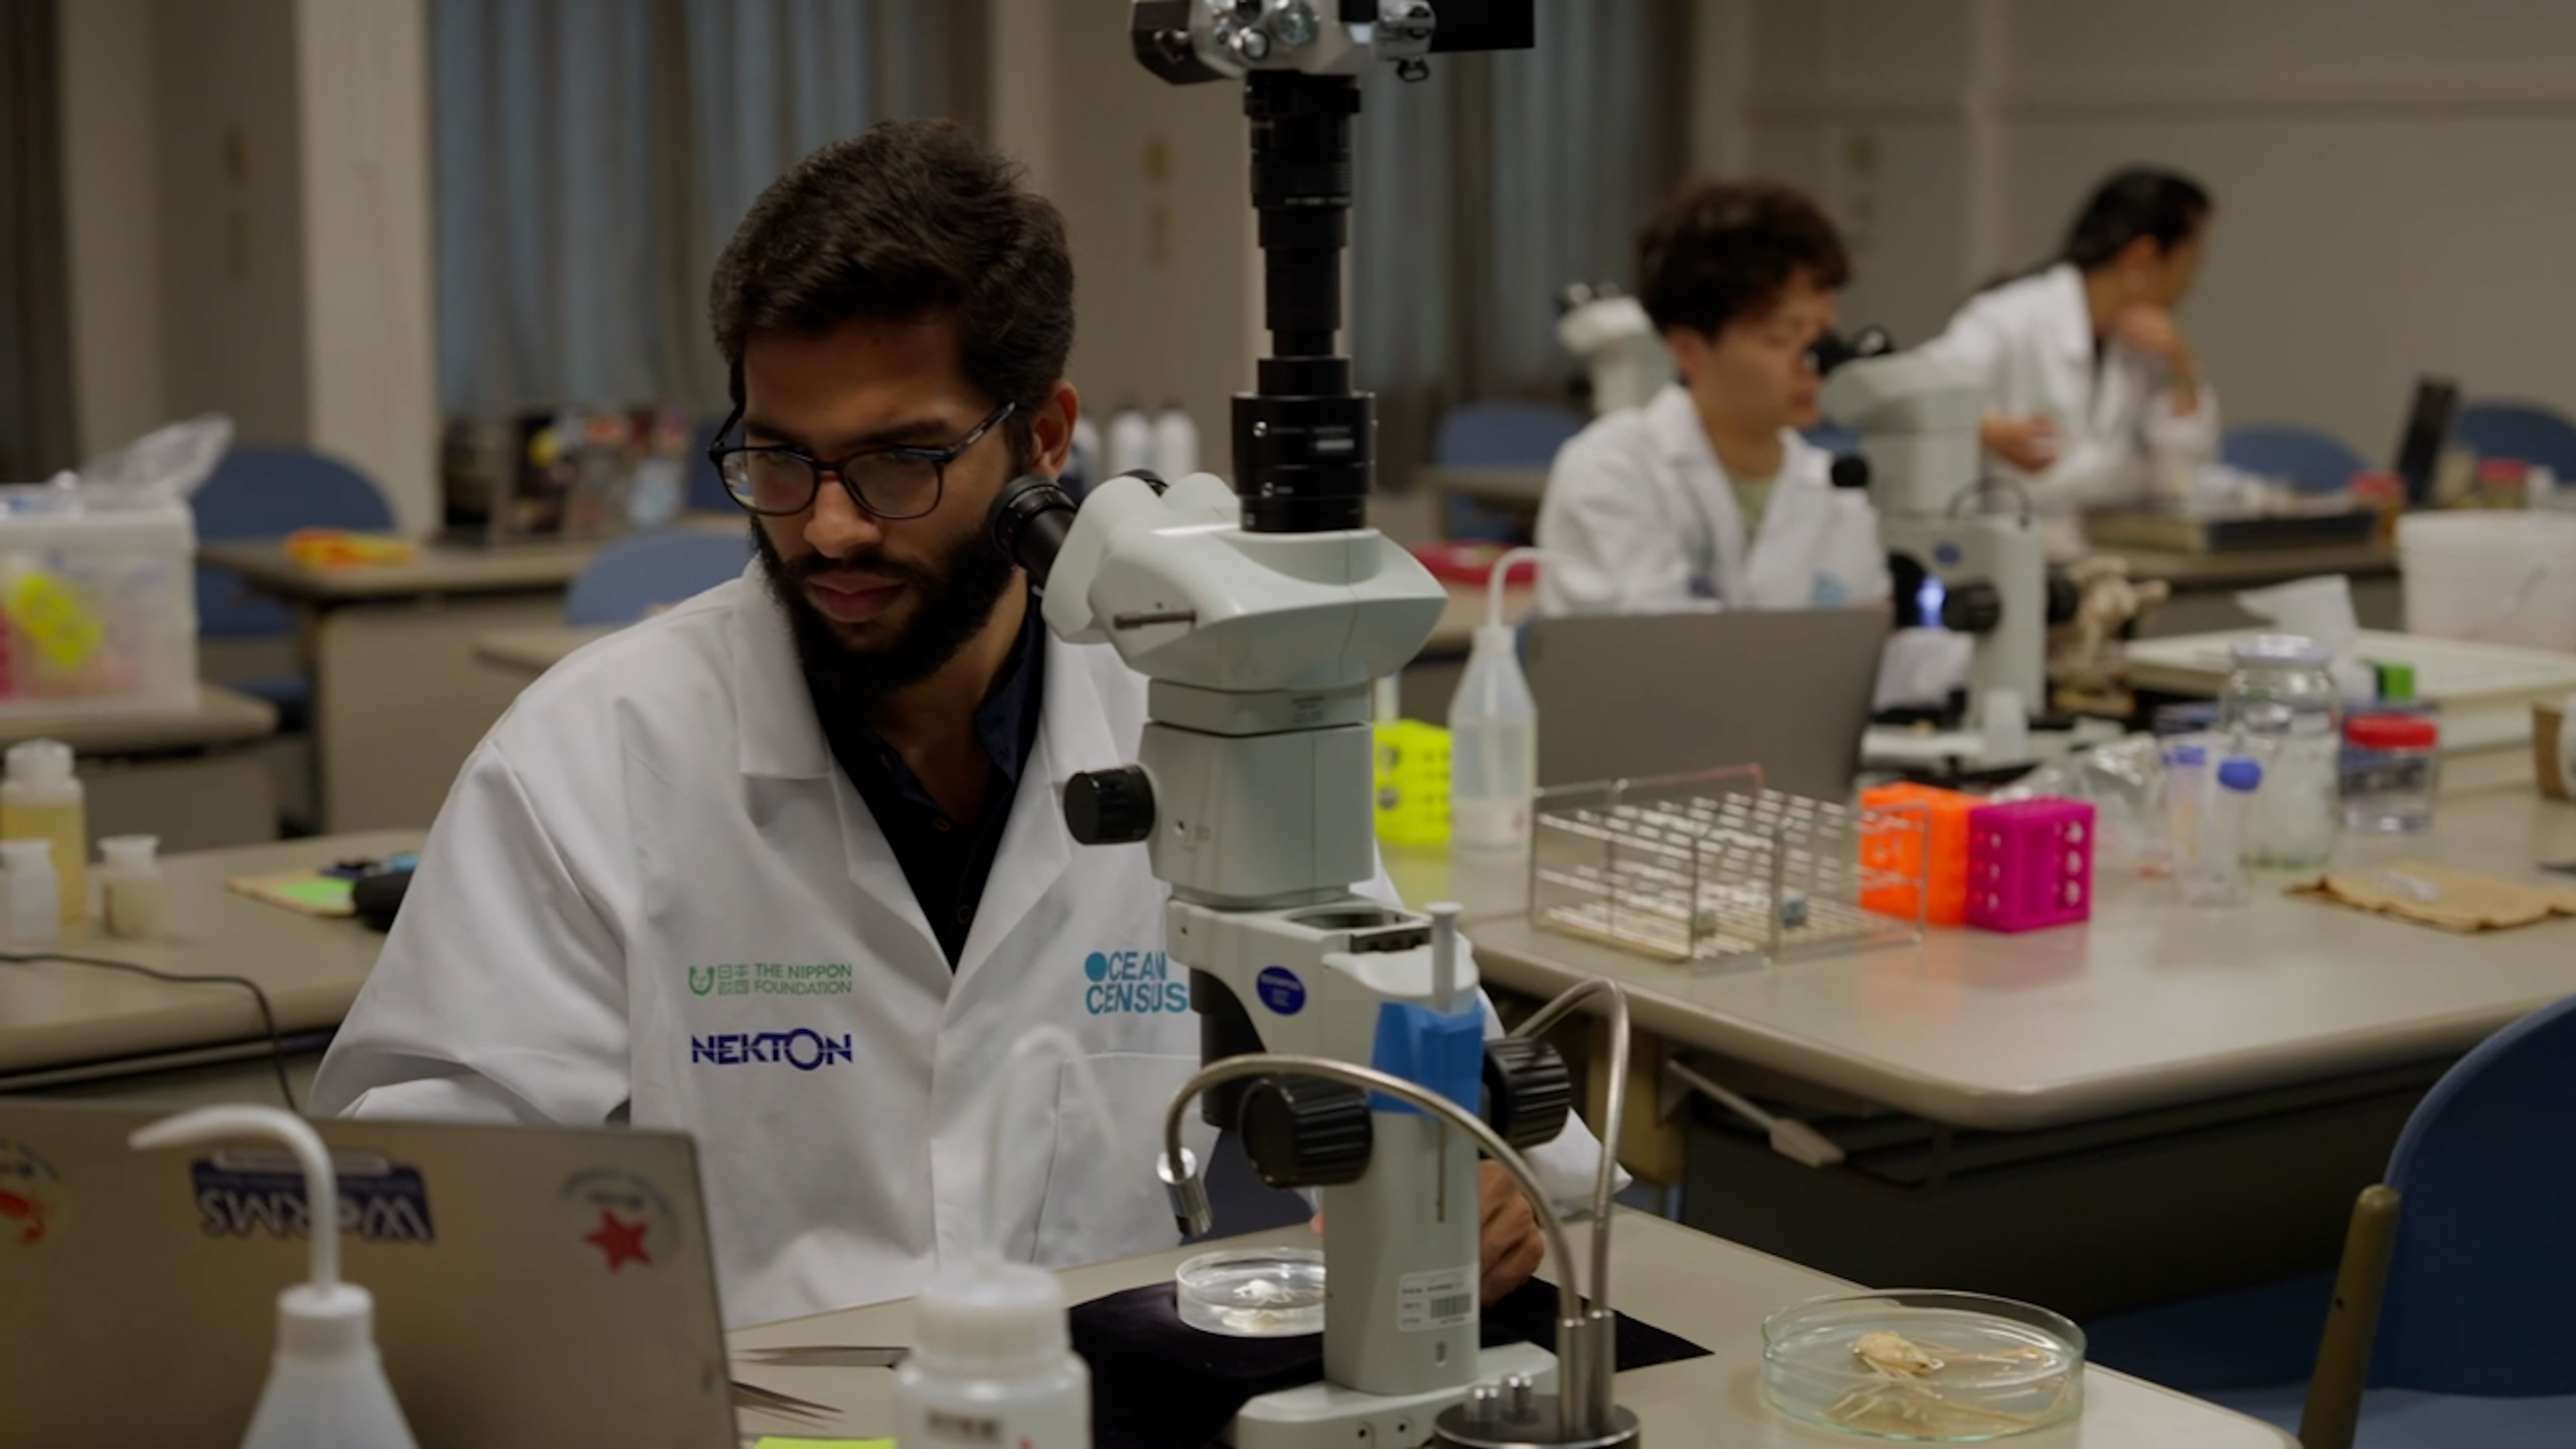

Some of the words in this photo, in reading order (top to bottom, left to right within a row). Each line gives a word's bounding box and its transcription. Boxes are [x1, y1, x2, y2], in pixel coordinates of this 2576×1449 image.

[755, 963, 784, 978] THE
[788, 963, 852, 979] NIPPON
[1085, 951, 1167, 982] OCEAN
[754, 979, 852, 996] FOUNDATION
[1085, 983, 1188, 1015] CENSUS
[691, 1028, 853, 1071] NEKTON
